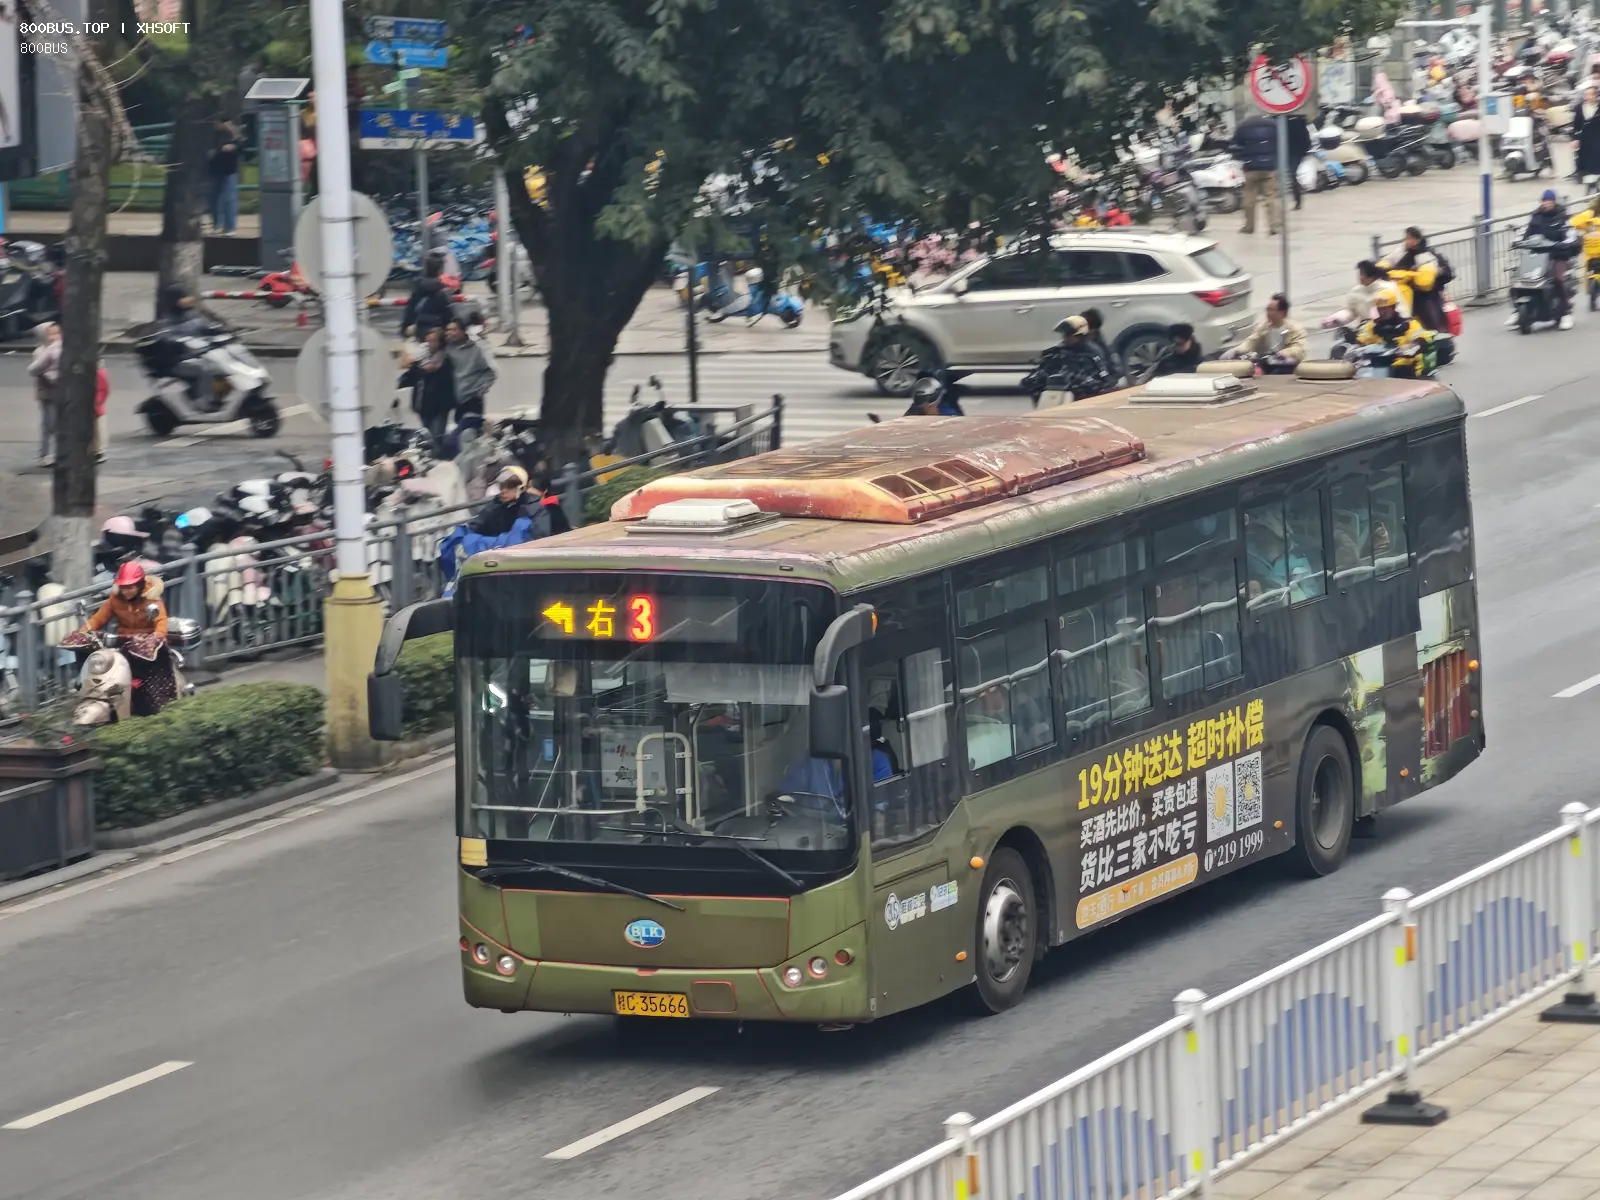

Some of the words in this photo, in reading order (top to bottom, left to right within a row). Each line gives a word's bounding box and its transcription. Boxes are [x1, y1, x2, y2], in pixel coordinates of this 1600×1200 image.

[586, 599, 616, 637] 右
[631, 596, 653, 641] 3
[1078, 729, 1183, 810] 19分钟送达
[1187, 698, 1264, 772] 超时补偿
[1079, 811, 1198, 893] 货比三家不吃亏
